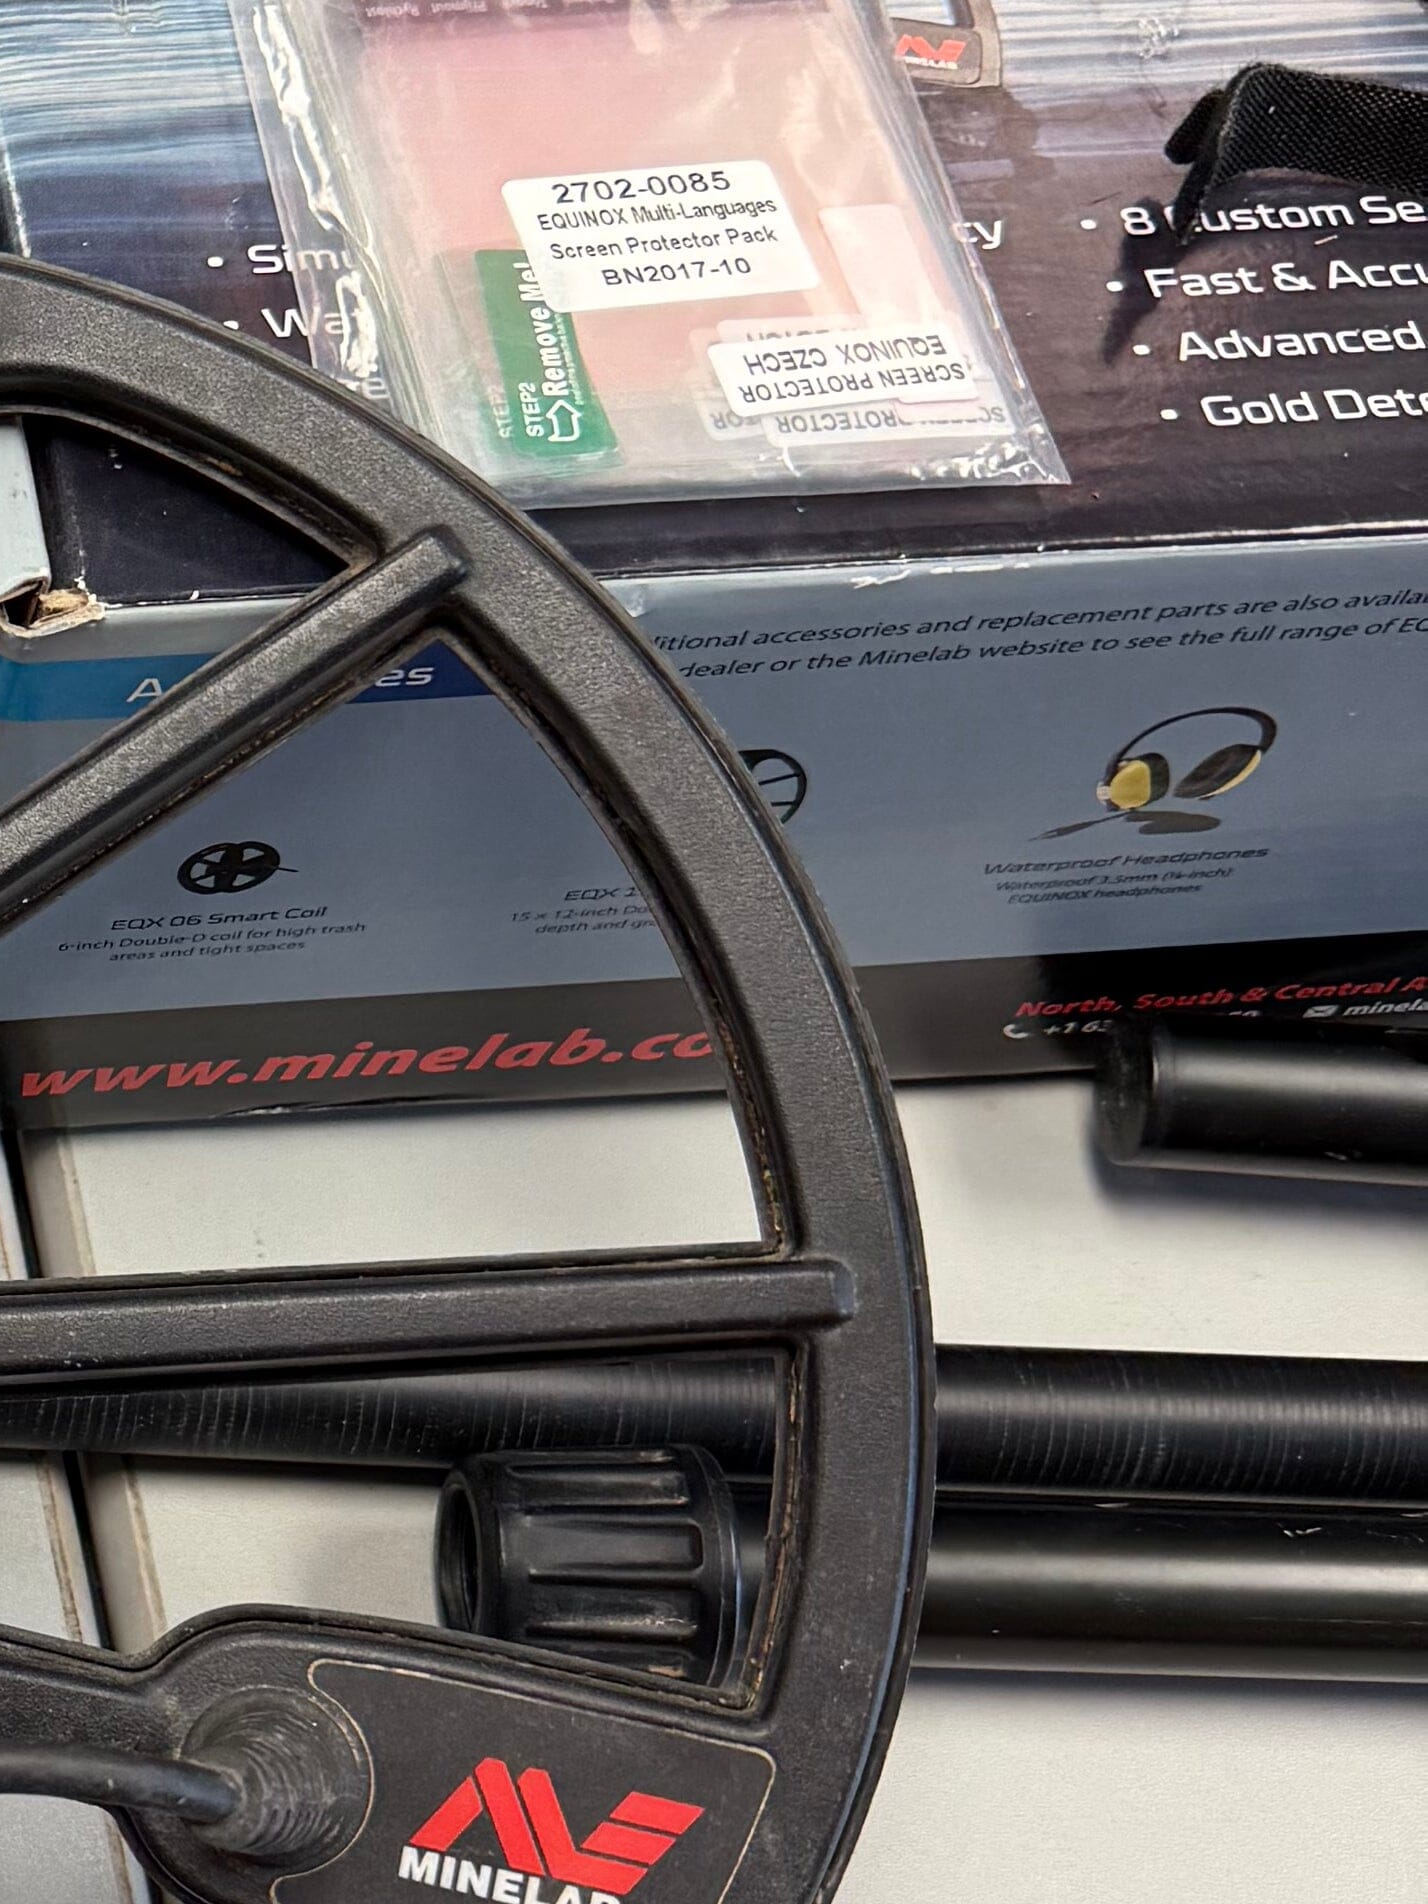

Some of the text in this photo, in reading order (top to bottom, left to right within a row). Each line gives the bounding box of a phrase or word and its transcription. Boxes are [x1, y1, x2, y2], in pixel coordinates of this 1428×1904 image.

[551, 170, 732, 205] 2702-0085
[537, 198, 779, 232] EQUINOX Multi-Languages
[1119, 206, 1157, 237] 8
[1359, 195, 1428, 225] Se
[548, 224, 780, 261] Screen Protector Pack
[950, 216, 1005, 249] cy
[600, 256, 753, 287] BN2017-10
[1144, 259, 1428, 299] Fast & Accu
[529, 306, 570, 398] Remove
[834, 334, 948, 367] EQUINOX
[1178, 320, 1426, 363] Advanced
[743, 347, 829, 377] CZECH
[737, 362, 967, 404] SCREEN PROTECTOR
[518, 382, 546, 438] STEP2
[776, 408, 902, 434] ROTECTOR
[1198, 387, 1428, 427] Gold Det
[753, 620, 912, 647] accessories
[916, 613, 977, 636] and
[977, 605, 1152, 634] replacement
[1154, 601, 1228, 624] parts
[1232, 597, 1279, 616] are
[1282, 593, 1339, 611] also
[1343, 588, 1428, 609] availa
[769, 656, 802, 674] or
[806, 652, 853, 671] the
[857, 644, 972, 668] Minelab
[978, 636, 1085, 659] website
[1090, 636, 1120, 653] to
[1123, 633, 1173, 650] see
[1178, 628, 1226, 647] the
[1228, 624, 1277, 645] full
[1278, 622, 1360, 643] range
[1363, 617, 1401, 636] of
[984, 847, 1271, 876] Waterproof Headphones
[564, 887, 621, 902] EQX
[995, 874, 1096, 892] Waterproof
[1007, 882, 1204, 905] EQUINOX headphones
[110, 905, 329, 932] EQX 06 Smart Coil
[534, 921, 590, 935] depth
[592, 918, 629, 931] and
[553, 904, 619, 920] 12-inch
[57, 921, 367, 953] 6-inch Double-D coil for high trash
[108, 940, 307, 962] areas and tight spaces
[1013, 975, 1428, 1019] North, South & Central A
[1342, 997, 1428, 1017] minela
[21, 1027, 713, 1097] www.minelab.co
